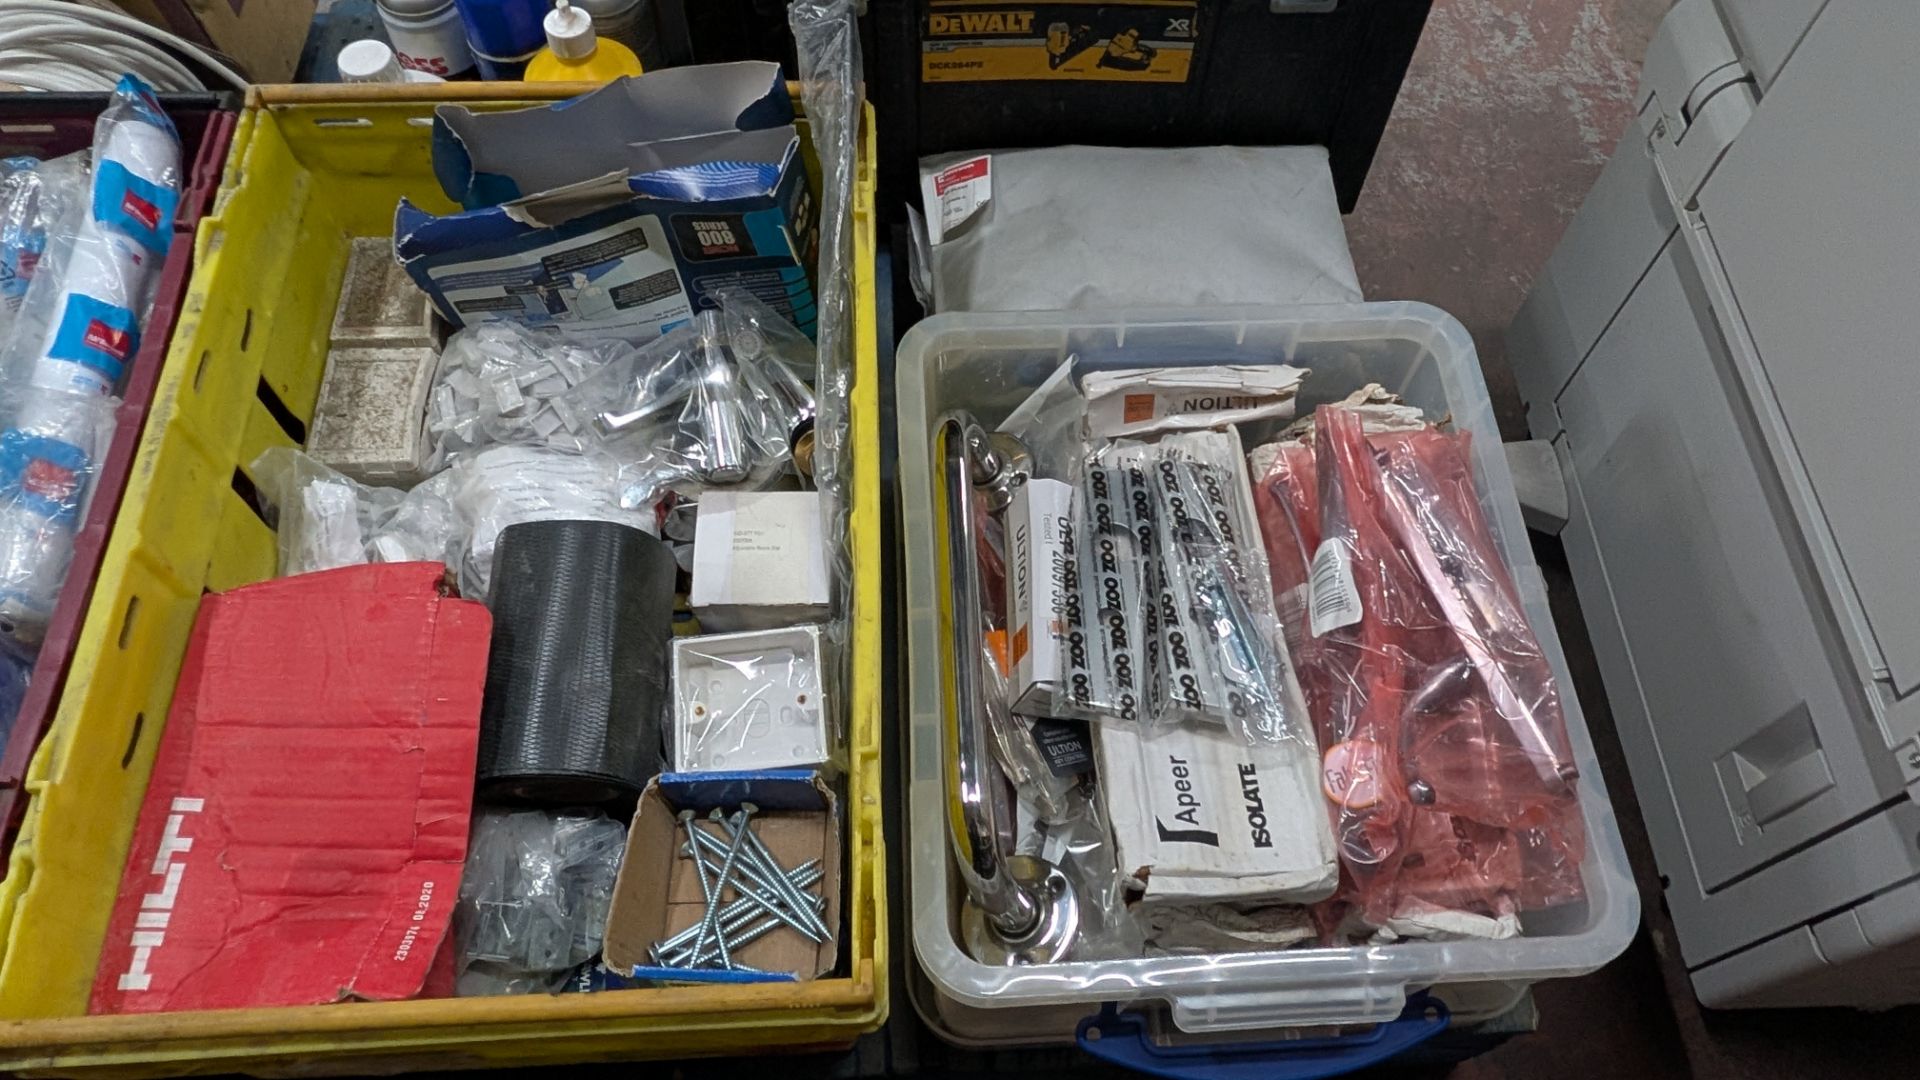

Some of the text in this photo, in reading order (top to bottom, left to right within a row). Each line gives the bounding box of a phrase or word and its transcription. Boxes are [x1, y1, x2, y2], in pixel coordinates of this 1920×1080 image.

[1166, 18, 1190, 31] XR
[692, 220, 730, 232] SERIES
[698, 230, 736, 247] 800
[1184, 395, 1259, 412] ULTION
[1091, 470, 1108, 499] ZOO
[1159, 460, 1180, 493] ZOO
[1203, 474, 1224, 506] ZOO
[1095, 502, 1113, 536] ZOO
[1133, 490, 1150, 521] ZOO
[1016, 524, 1028, 600] ULTION
[1100, 539, 1117, 574] ZOO
[1066, 593, 1081, 627] ZOO
[1104, 576, 1122, 611] ZOO
[1161, 593, 1180, 628] ZOO
[1109, 614, 1128, 650] ZOO
[1069, 631, 1086, 670] ZOO
[1168, 631, 1191, 670] ZOO
[1115, 653, 1133, 690] ZOO
[1180, 674, 1202, 711] ZOO
[1047, 740, 1083, 757] ULTION
[1169, 754, 1201, 826] Apeer
[1237, 762, 1273, 848] ISOLATE
[117, 797, 205, 991] HILTI
